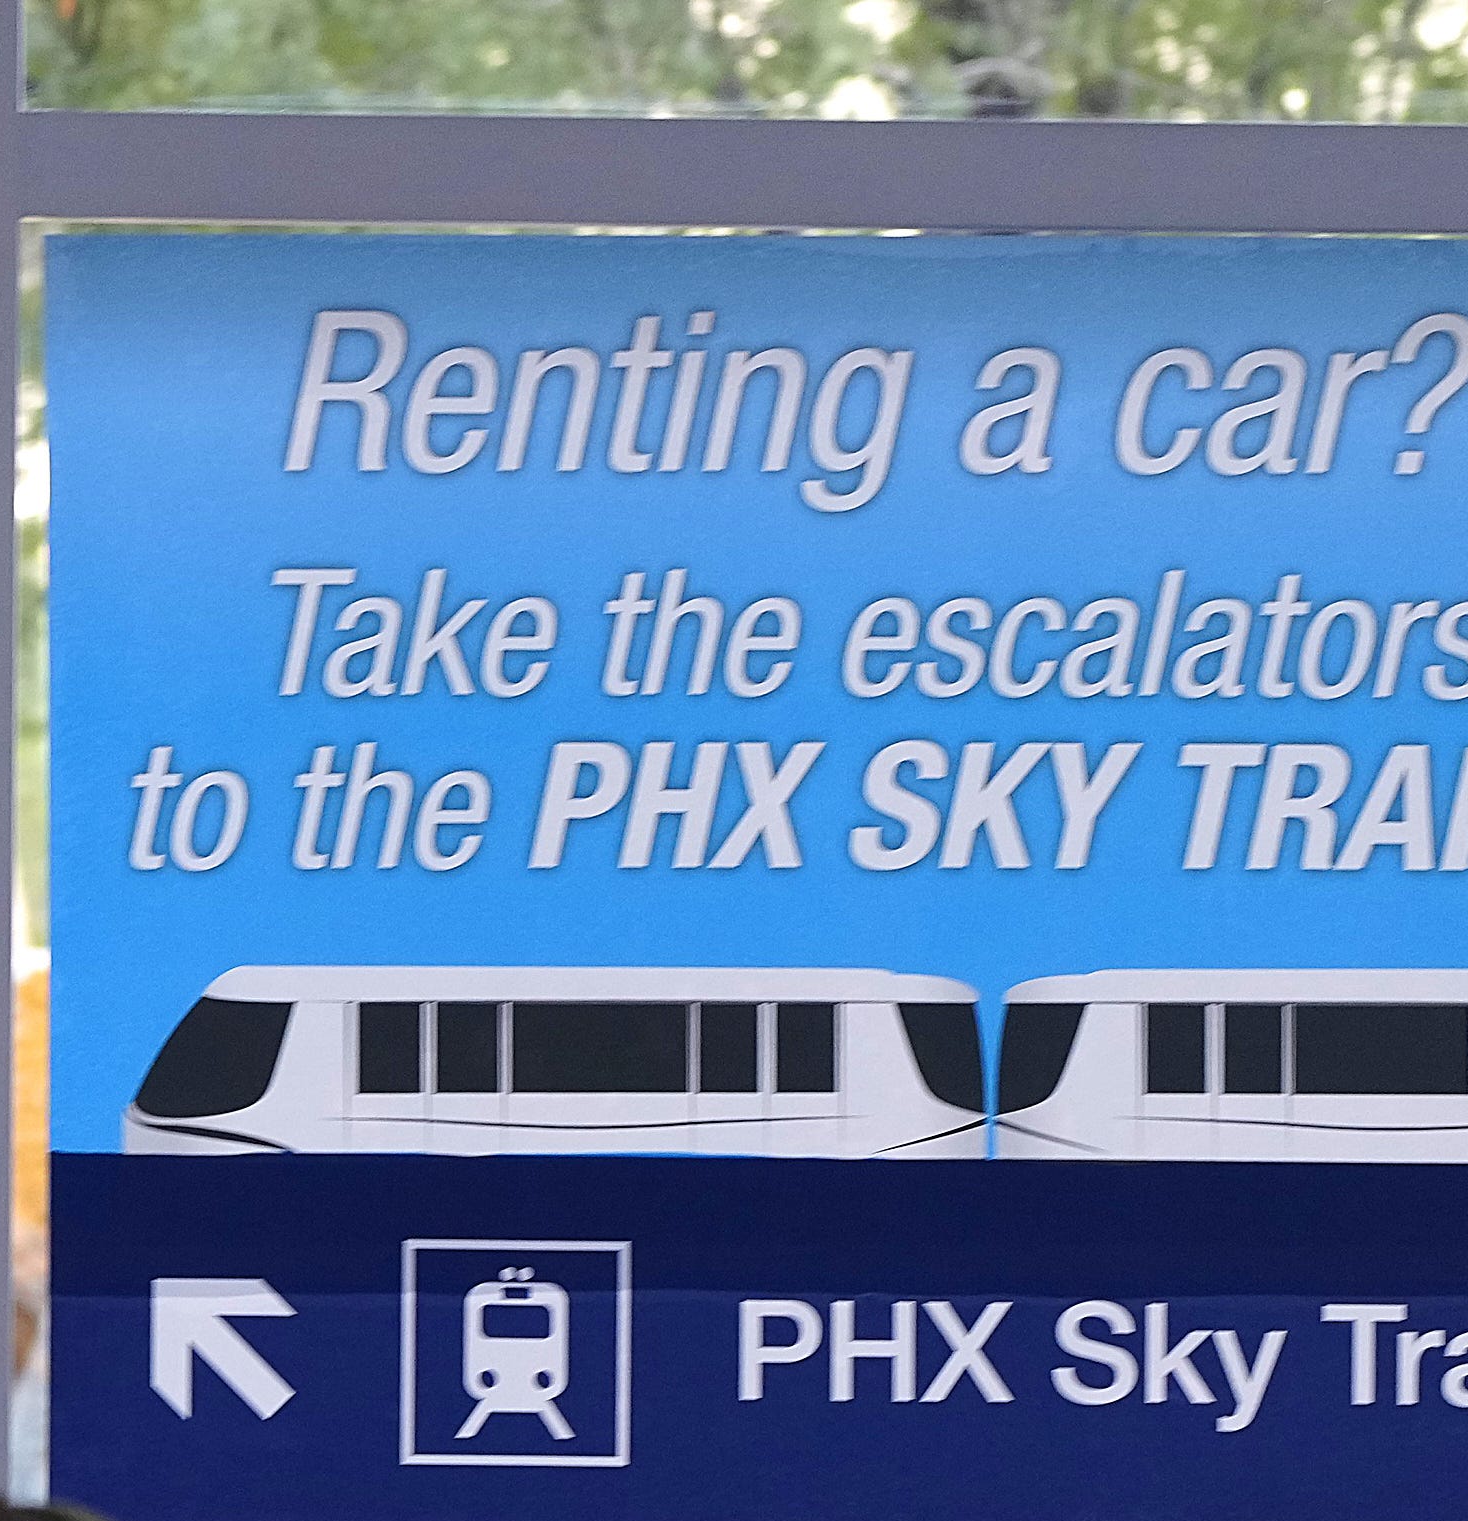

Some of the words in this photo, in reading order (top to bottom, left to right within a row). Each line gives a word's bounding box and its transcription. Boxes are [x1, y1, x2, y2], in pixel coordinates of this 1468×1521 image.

[283, 310, 914, 513] Renting
[960, 347, 1060, 475] a
[271, 567, 558, 699] Take
[602, 567, 802, 699] the
[129, 745, 249, 872] to
[292, 741, 492, 872] the
[527, 740, 827, 870] PHX
[849, 739, 1144, 872] SKY
[737, 1298, 1015, 1404] PHX
[1050, 1298, 1289, 1433] Sky
